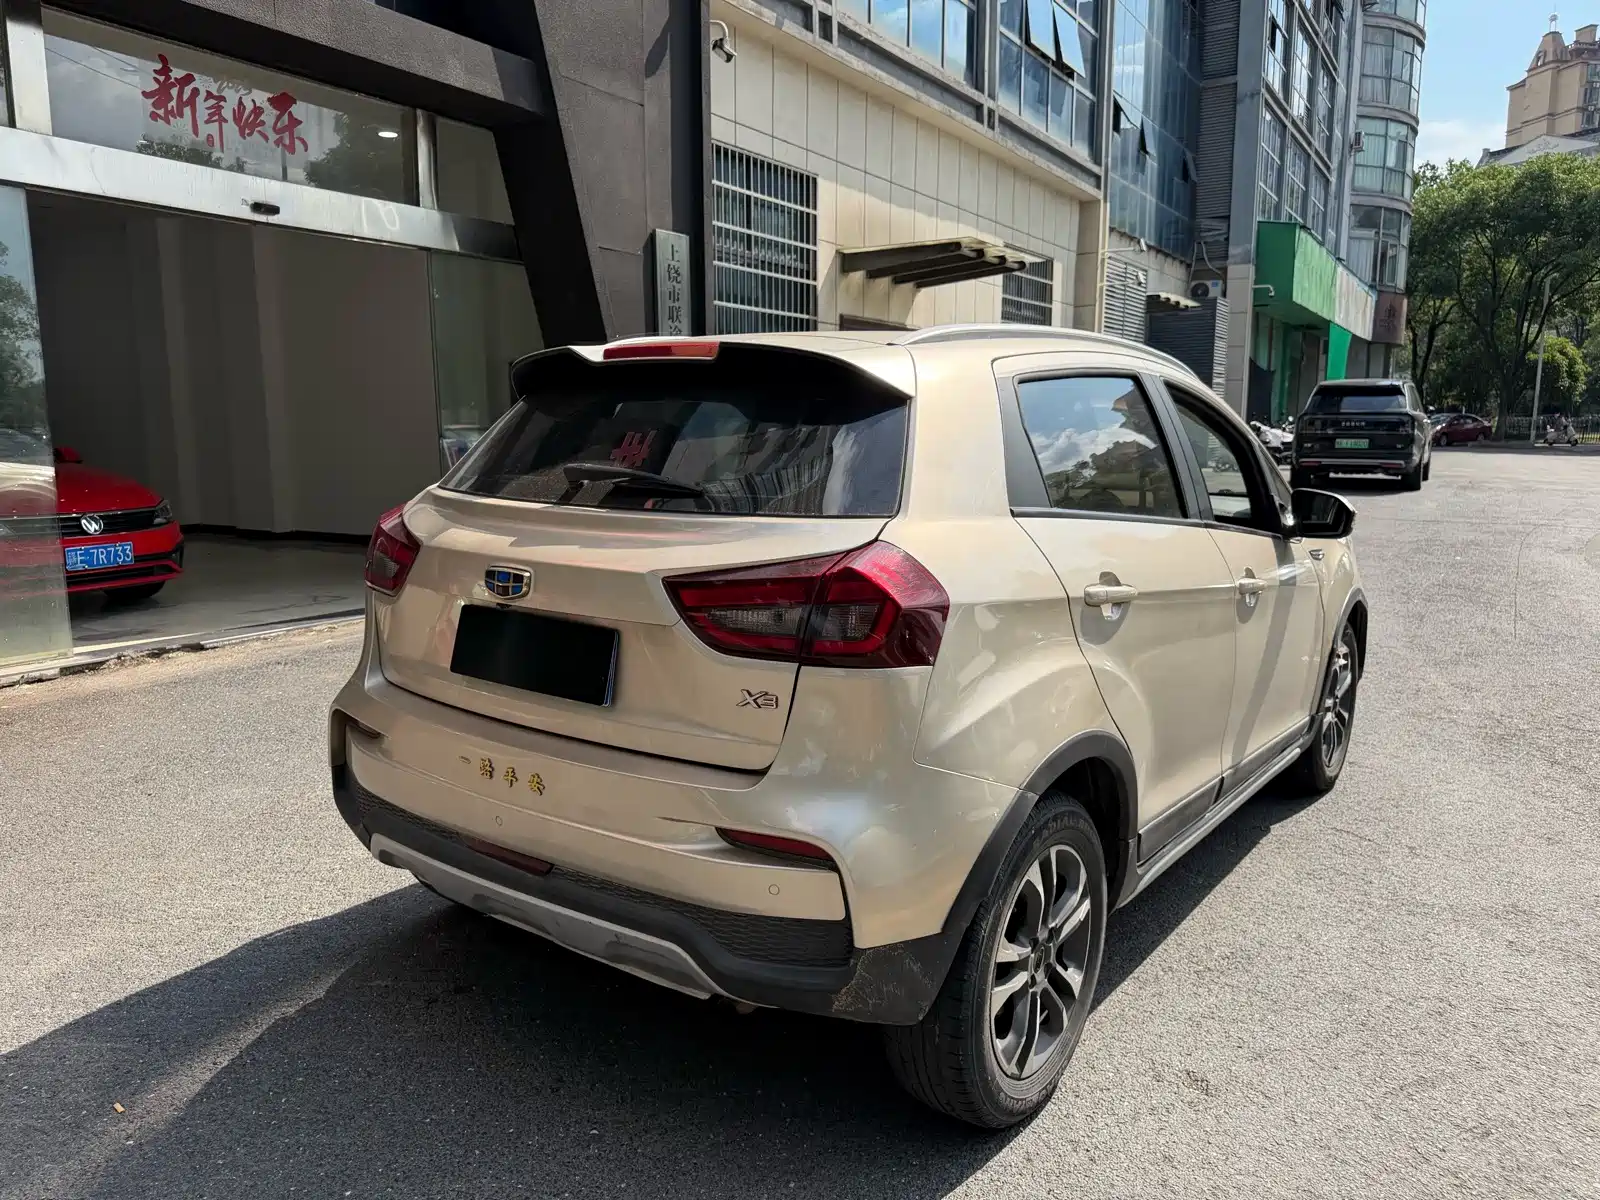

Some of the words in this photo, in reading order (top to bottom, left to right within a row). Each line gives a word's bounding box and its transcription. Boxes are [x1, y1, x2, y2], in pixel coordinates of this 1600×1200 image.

[142, 54, 308, 155] 新年快乐
[736, 688, 778, 709] X3
[459, 756, 546, 796] 一路平安
